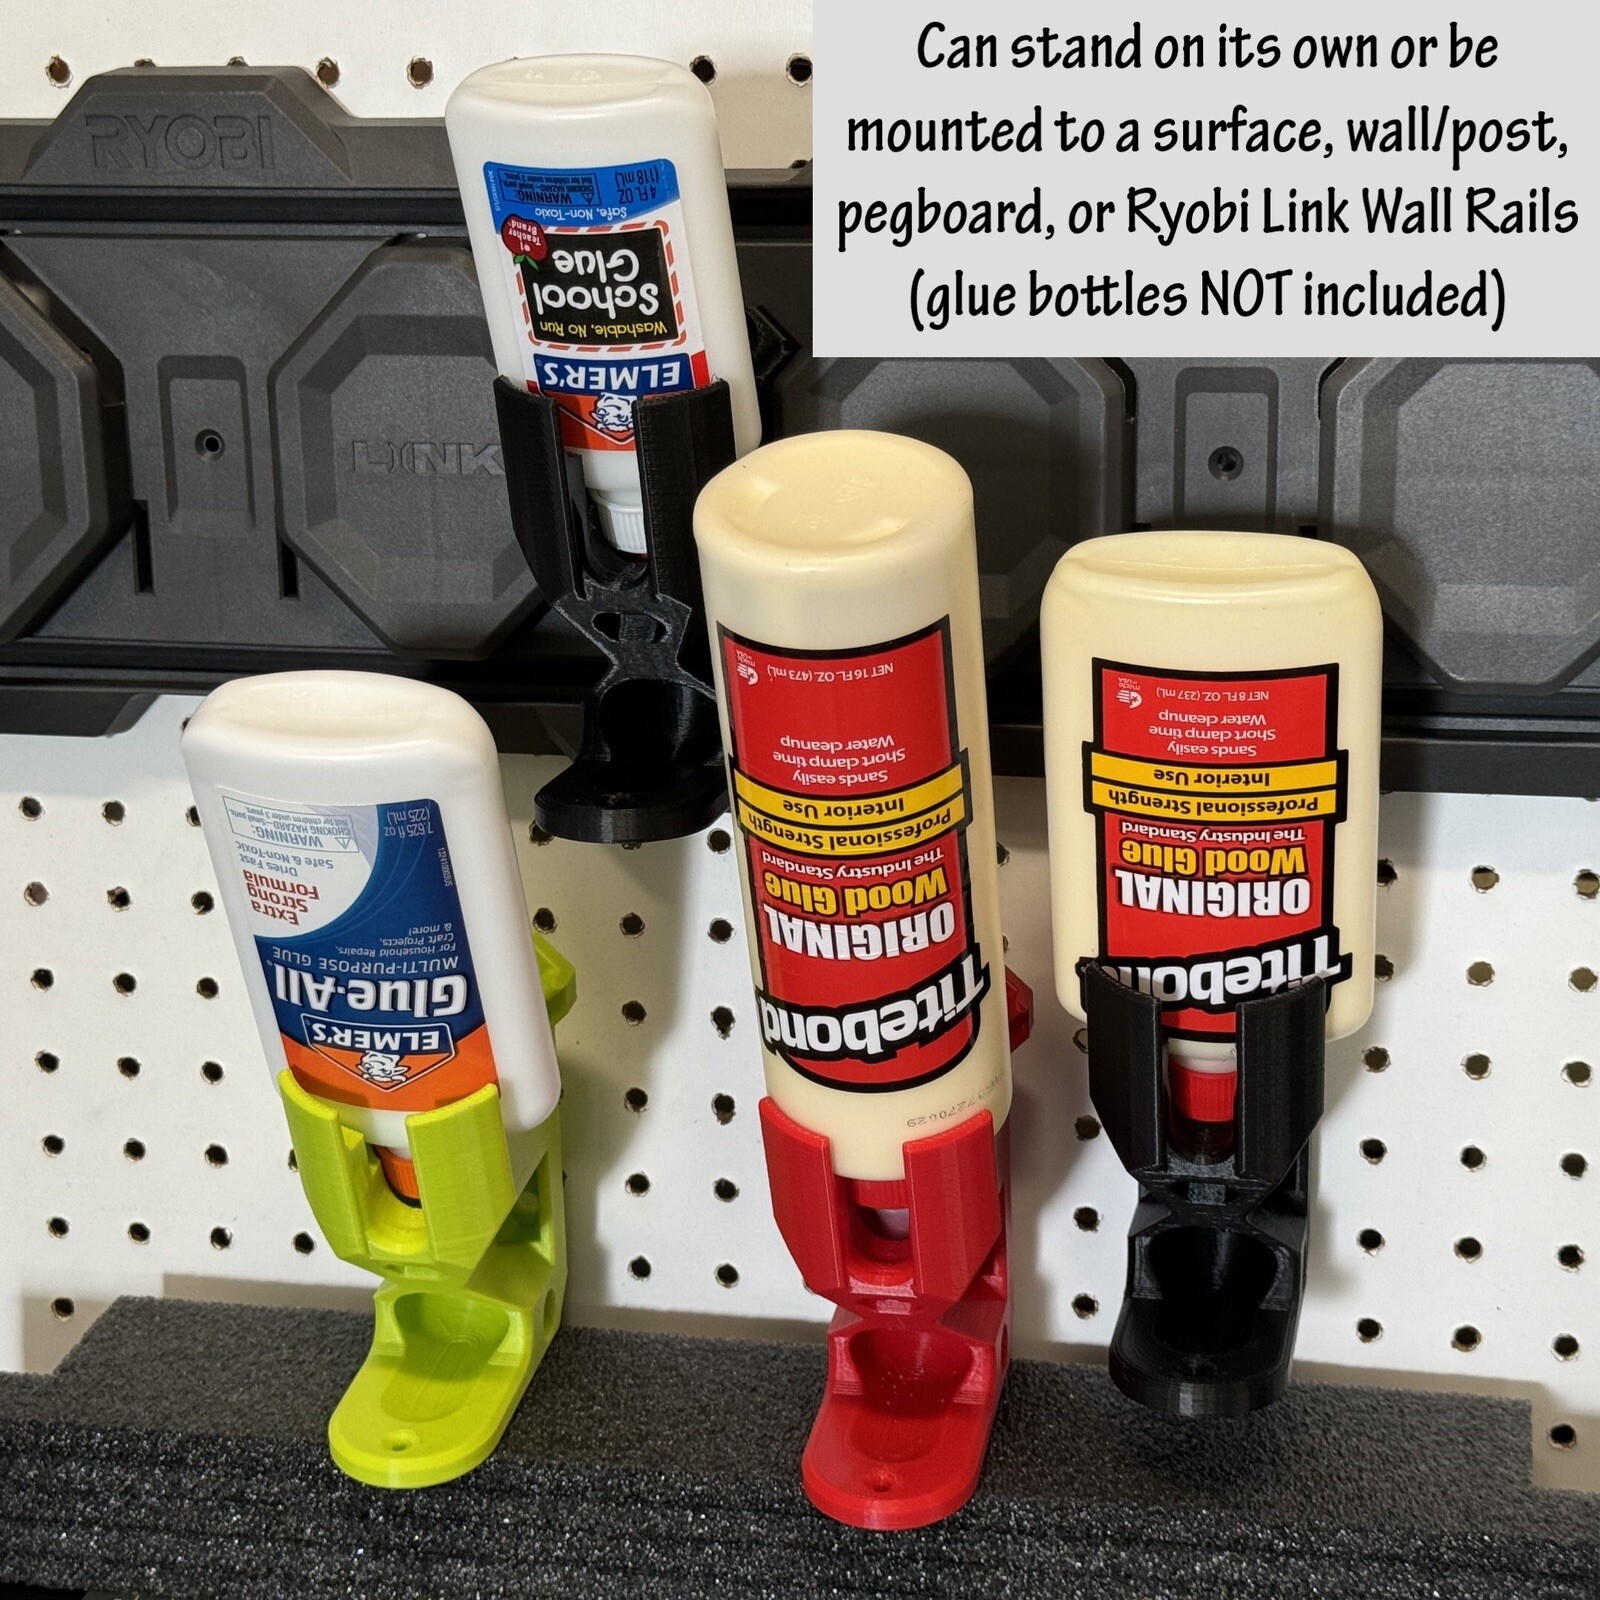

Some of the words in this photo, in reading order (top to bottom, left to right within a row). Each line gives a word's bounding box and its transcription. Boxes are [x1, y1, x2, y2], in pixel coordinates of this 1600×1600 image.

[85, 114, 274, 170] RYOBI
[615, 171, 635, 189] mL)
[637, 165, 659, 185] (118
[515, 190, 572, 205] WARNING:
[617, 189, 634, 204] OZ
[636, 186, 648, 201] FL
[650, 186, 656, 200] 4
[535, 208, 593, 221] Non-Toxic
[596, 207, 627, 221] Safe,
[511, 219, 537, 235] Brand
[509, 228, 541, 246] Teacher
[551, 249, 639, 281] Glue
[533, 283, 659, 319] School
[539, 321, 564, 337] Run
[568, 325, 587, 338] No
[591, 321, 667, 338] Washable,
[544, 361, 681, 389] ELMER'S
[767, 664, 787, 678] mL)
[788, 670, 812, 681] (473
[854, 668, 868, 678] 16
[871, 662, 894, 677] NET
[1118, 682, 1140, 691] made
[1156, 687, 1176, 698] mL)
[1178, 689, 1200, 701] (237
[1239, 691, 1246, 700] 8
[1248, 691, 1269, 701] NET
[1158, 709, 1218, 727] cleanup
[1221, 715, 1267, 726] Water
[1148, 725, 1183, 739] time
[1185, 727, 1232, 742] clamp
[1234, 729, 1277, 741] Short
[780, 735, 843, 754] cleanup
[846, 735, 894, 751] Water
[1167, 740, 1208, 756] easily
[1211, 745, 1257, 757] Sands
[773, 751, 807, 768] time
[809, 756, 859, 770] clamp
[862, 747, 906, 769] Short
[792, 769, 836, 786] easily
[838, 770, 888, 787] Sands
[1153, 769, 1189, 786] Use
[1193, 772, 1270, 787] Interior
[782, 799, 819, 818] Use
[824, 797, 904, 820] Interior
[1107, 788, 1192, 815] Strength
[1196, 797, 1319, 816] Professional
[387, 811, 406, 825] mL)
[408, 806, 430, 822] (225
[250, 825, 323, 848] WARNING:
[310, 826, 350, 836] CHOKING
[383, 826, 395, 836] oz
[398, 825, 405, 838] fl
[406, 822, 434, 836] 7.625
[747, 811, 824, 850] Strength
[829, 808, 951, 851] Professional
[1121, 821, 1197, 843] Standard
[1199, 828, 1271, 844] Industry
[1273, 828, 1305, 841] The
[235, 841, 290, 863] Non-Toxic
[291, 855, 302, 865] &
[914, 846, 944, 867] The
[1121, 841, 1197, 875] Glue
[239, 854, 263, 869] Fast
[305, 857, 334, 869] Safe
[761, 849, 833, 880] Standard
[836, 858, 912, 880] Industry
[1205, 846, 1306, 876] Wood
[266, 862, 298, 877] Dries
[243, 870, 320, 900] Formula
[764, 871, 836, 915] Glue
[845, 867, 947, 916] Wood
[1114, 868, 1311, 918] ORIGINAL
[246, 883, 308, 913] Strong
[251, 900, 299, 925] Extra
[408, 924, 440, 937] more!
[444, 922, 452, 932] &
[763, 902, 955, 961] ORIGINAL
[428, 932, 454, 945] Craft
[380, 946, 436, 958] Household
[438, 942, 456, 953] For
[272, 946, 311, 966] GLUE
[319, 956, 459, 974] MULTI-PURPOSE
[274, 962, 467, 1018] Glue-All
[759, 953, 984, 1055] Titebond
[311, 1023, 440, 1052] ELMER'S
